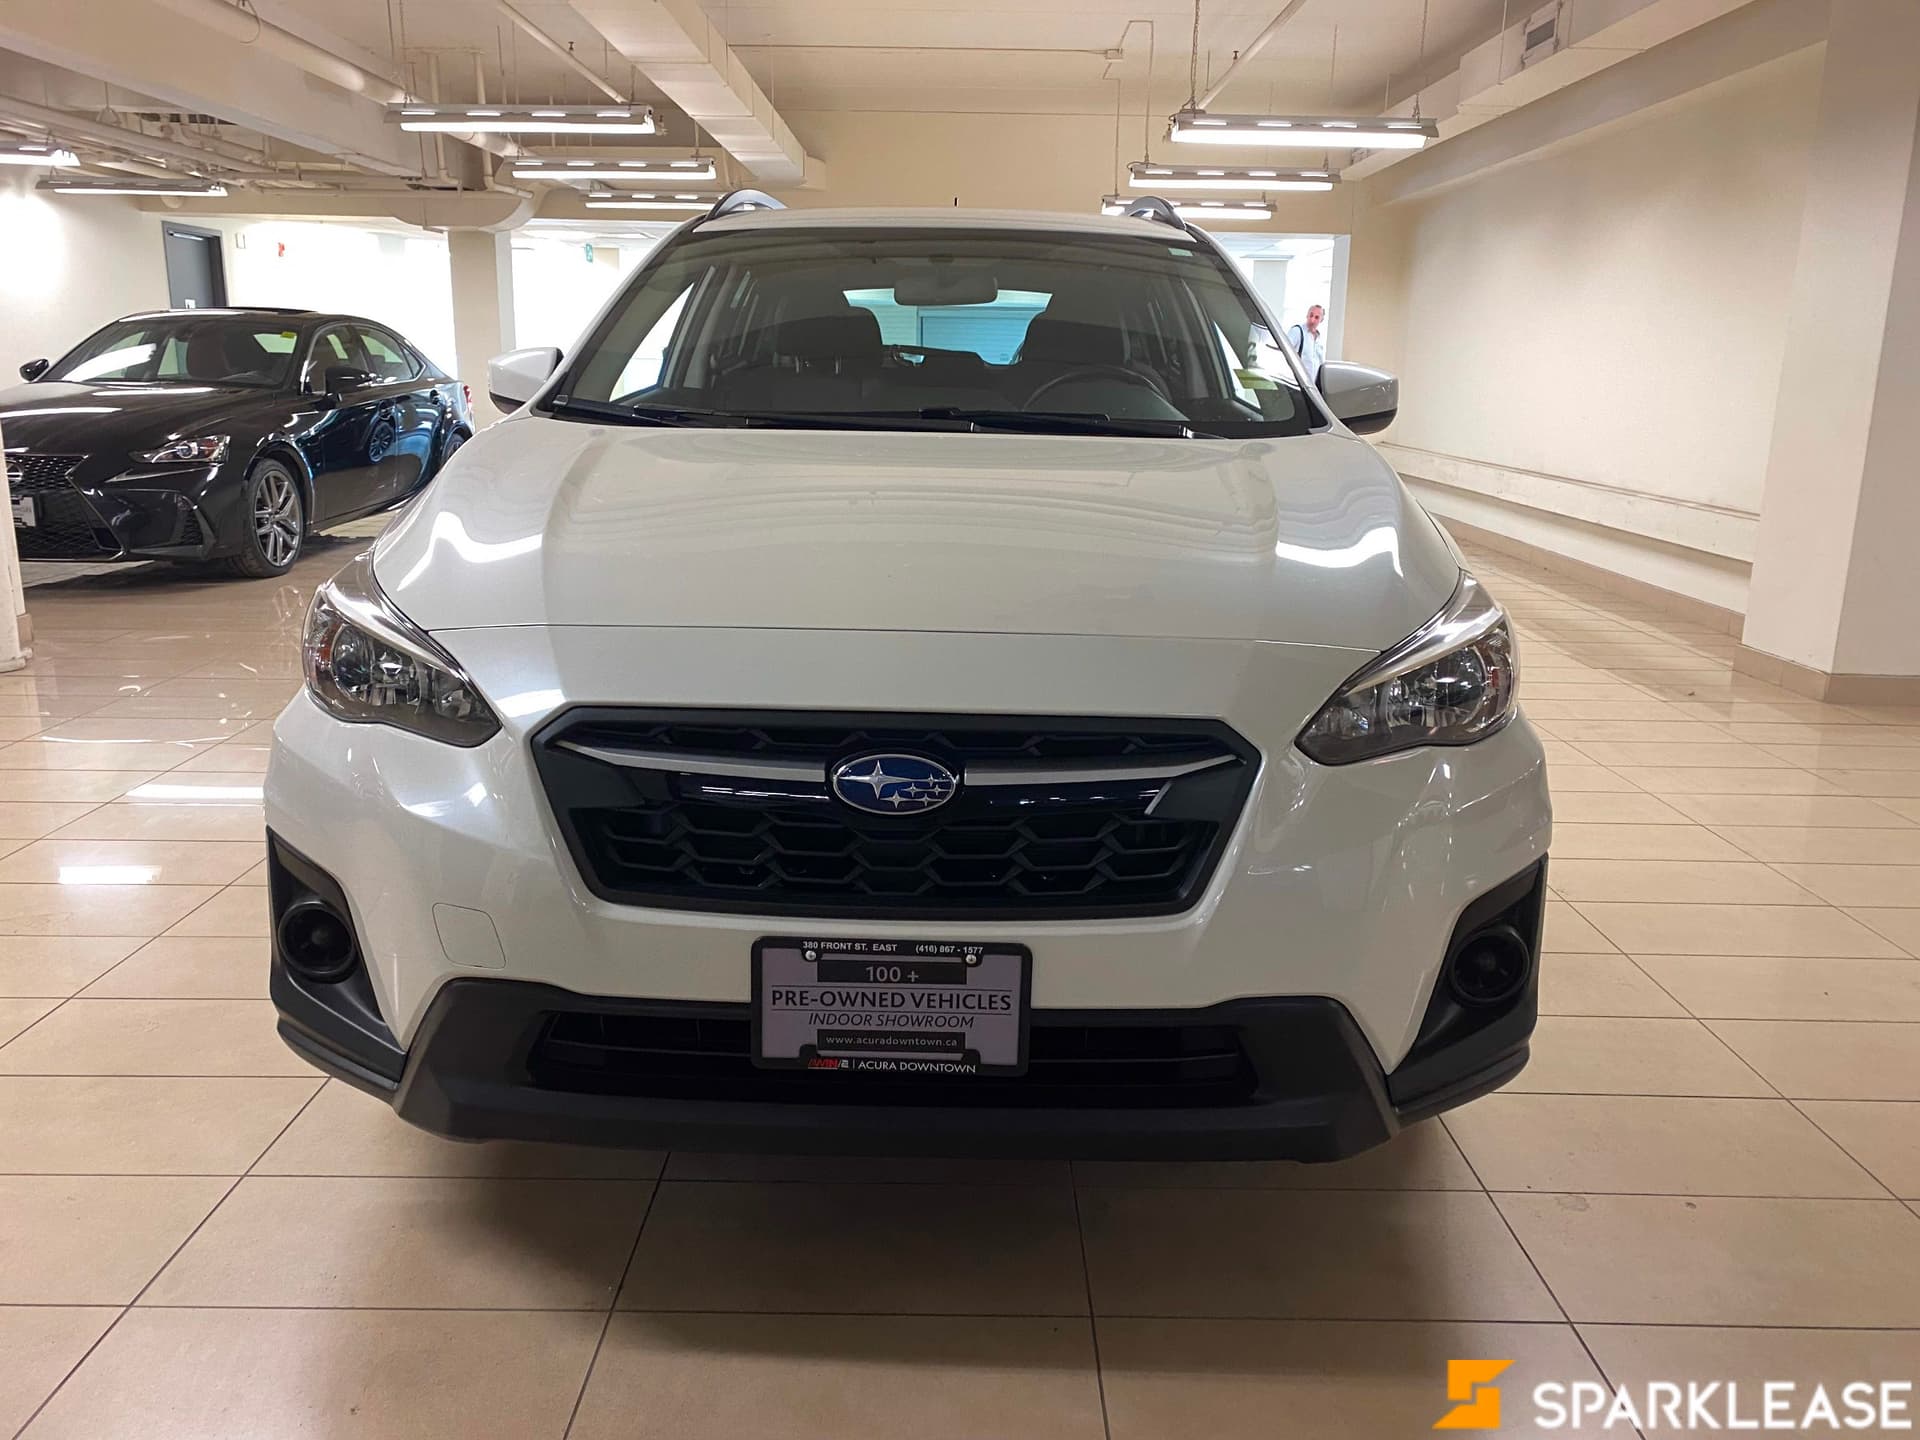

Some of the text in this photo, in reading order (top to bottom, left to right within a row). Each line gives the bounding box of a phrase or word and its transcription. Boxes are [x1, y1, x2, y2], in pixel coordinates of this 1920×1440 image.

[803, 941, 898, 951] 380 FRONT ST. EAST
[963, 946, 984, 954] 1577
[865, 966, 901, 982] 100
[771, 990, 1012, 1010] PRE-OWNED VEHICLES
[808, 1012, 974, 1029] INDOOR SHOWROOM
[825, 1035, 957, 1047] www.acuradowntown.ca
[858, 1060, 897, 1070] ACURA
[900, 1062, 976, 1073] DOWNTOWN
